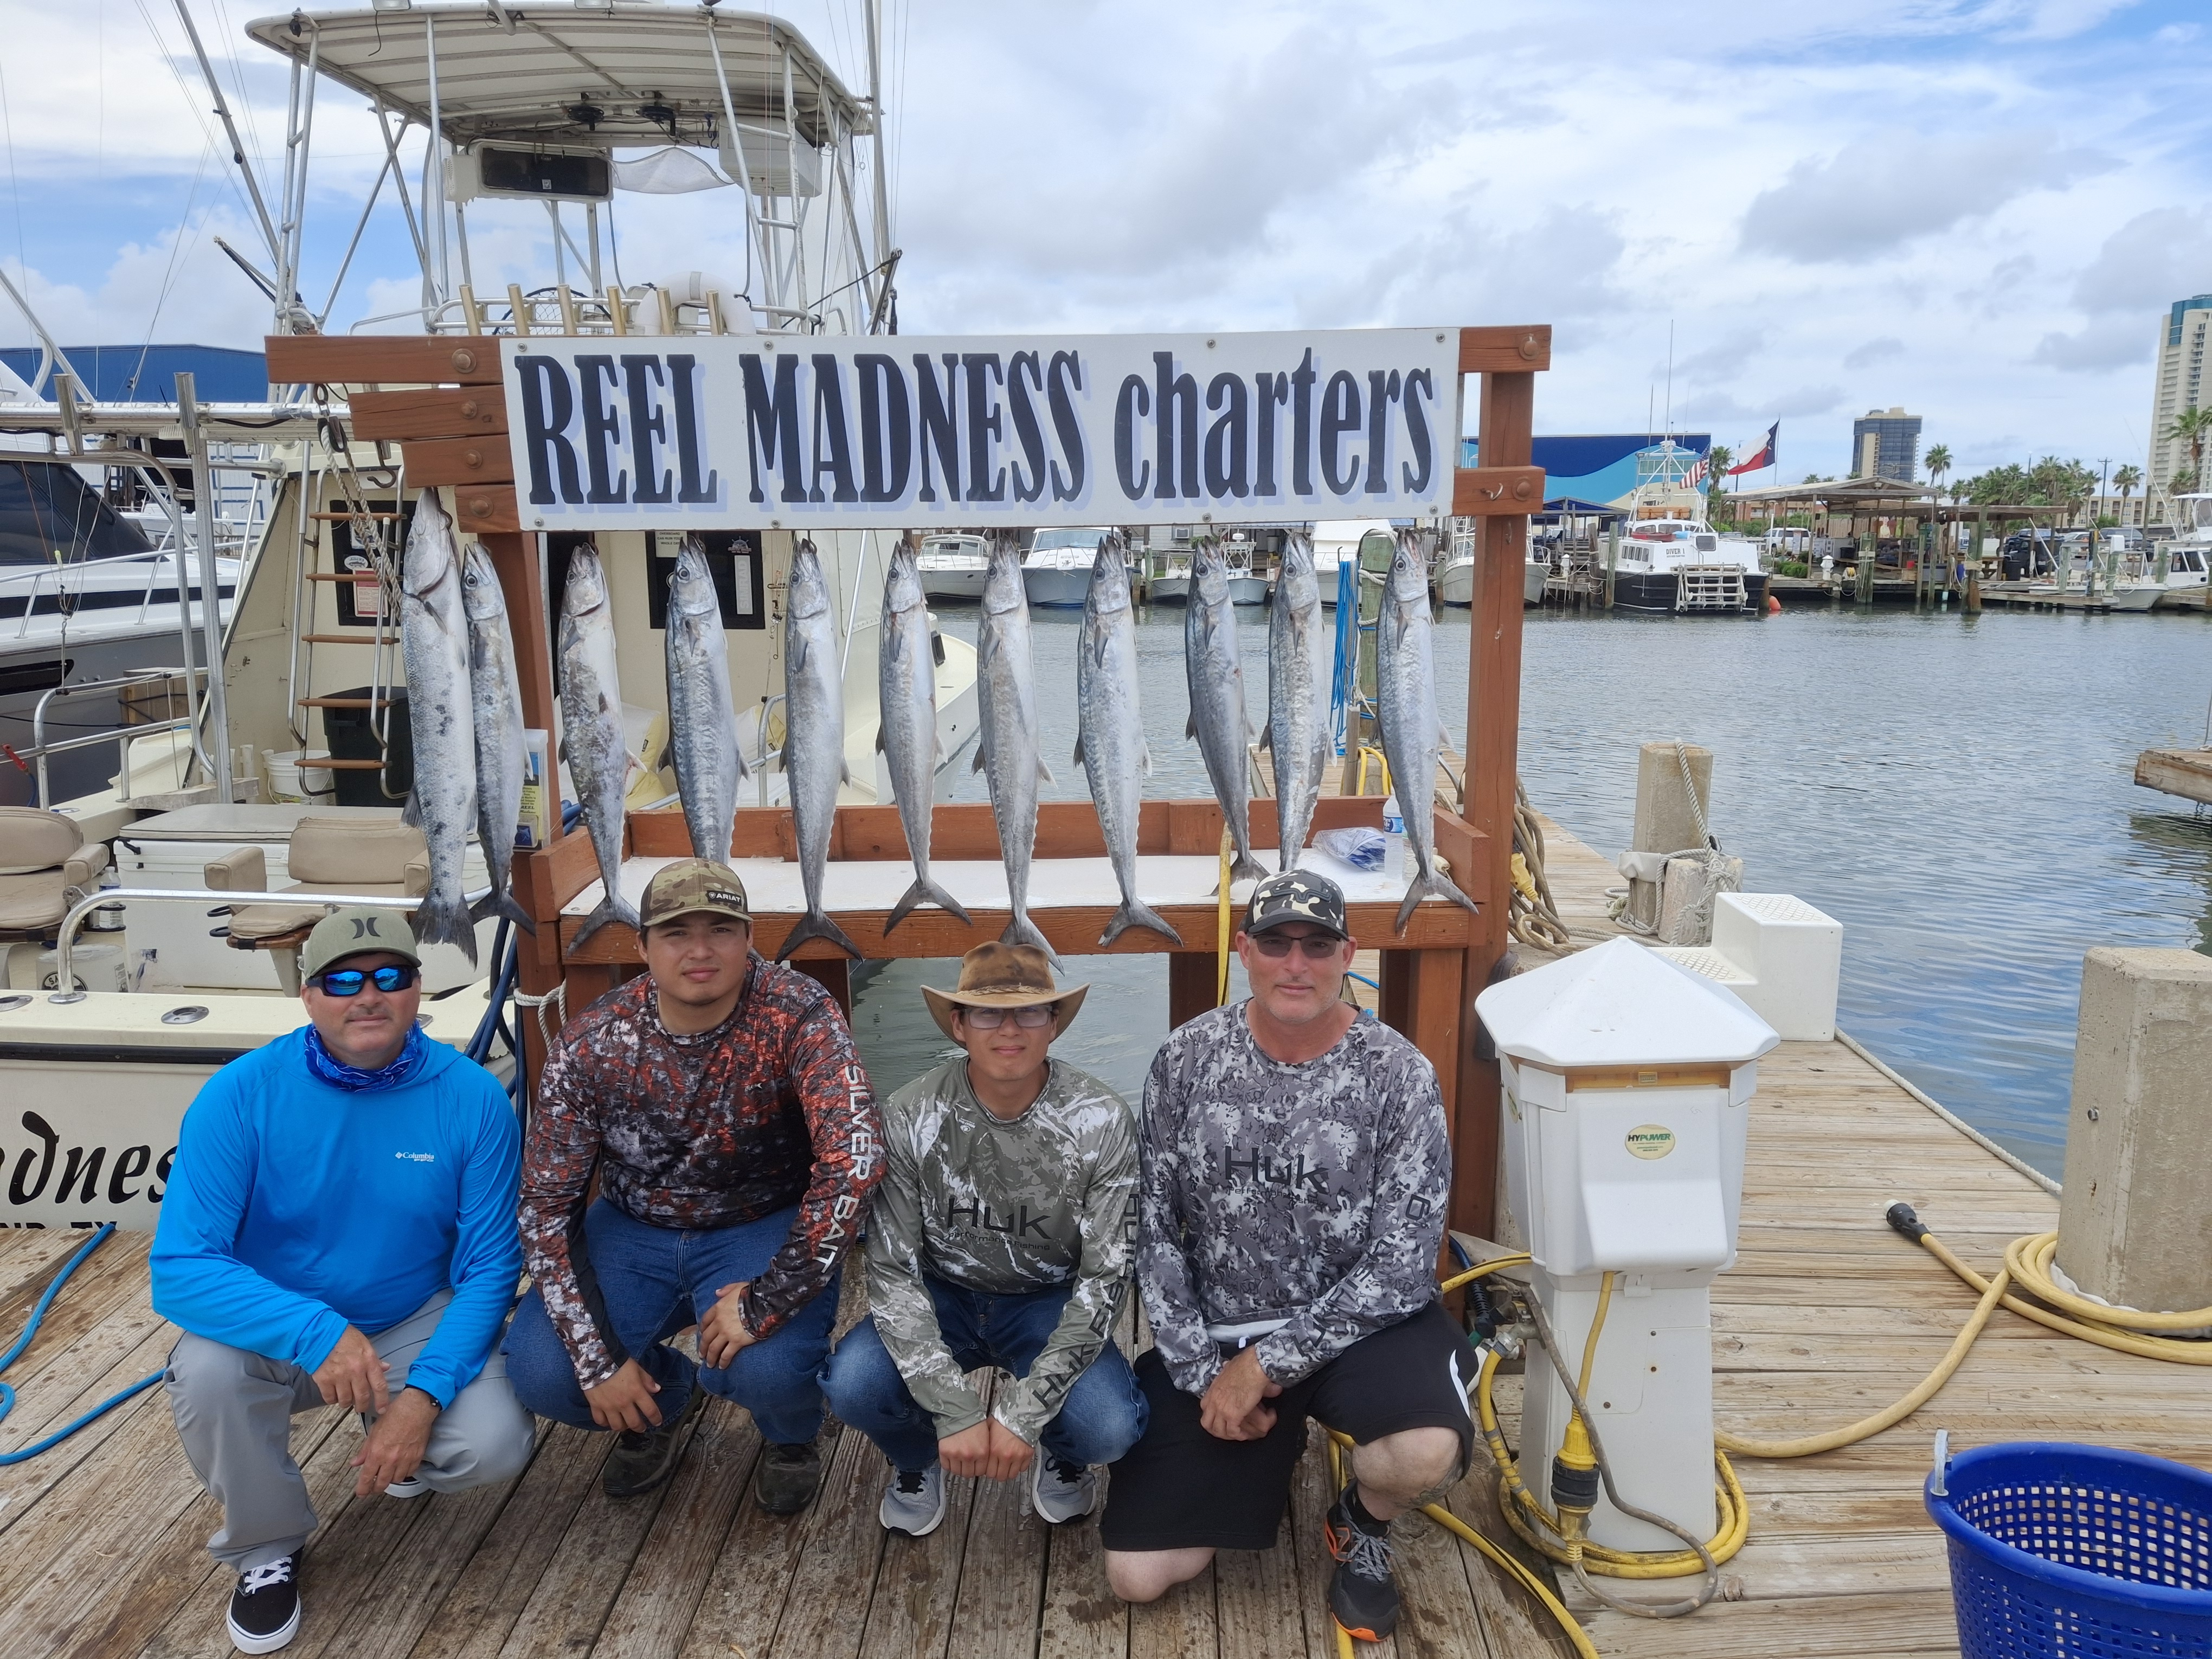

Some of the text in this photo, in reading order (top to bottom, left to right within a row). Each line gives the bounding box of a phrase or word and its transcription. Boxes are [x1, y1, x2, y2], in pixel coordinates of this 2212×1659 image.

[514, 347, 1432, 504] REEL MADNESS charters
[738, 560, 749, 609] SIMRAD
[716, 893, 741, 903] ARIAT
[1628, 1133, 1671, 1142] HYPOWER
[812, 1065, 872, 1274] SILVER BAIT
[949, 1231, 1050, 1251] Performance Fishing
